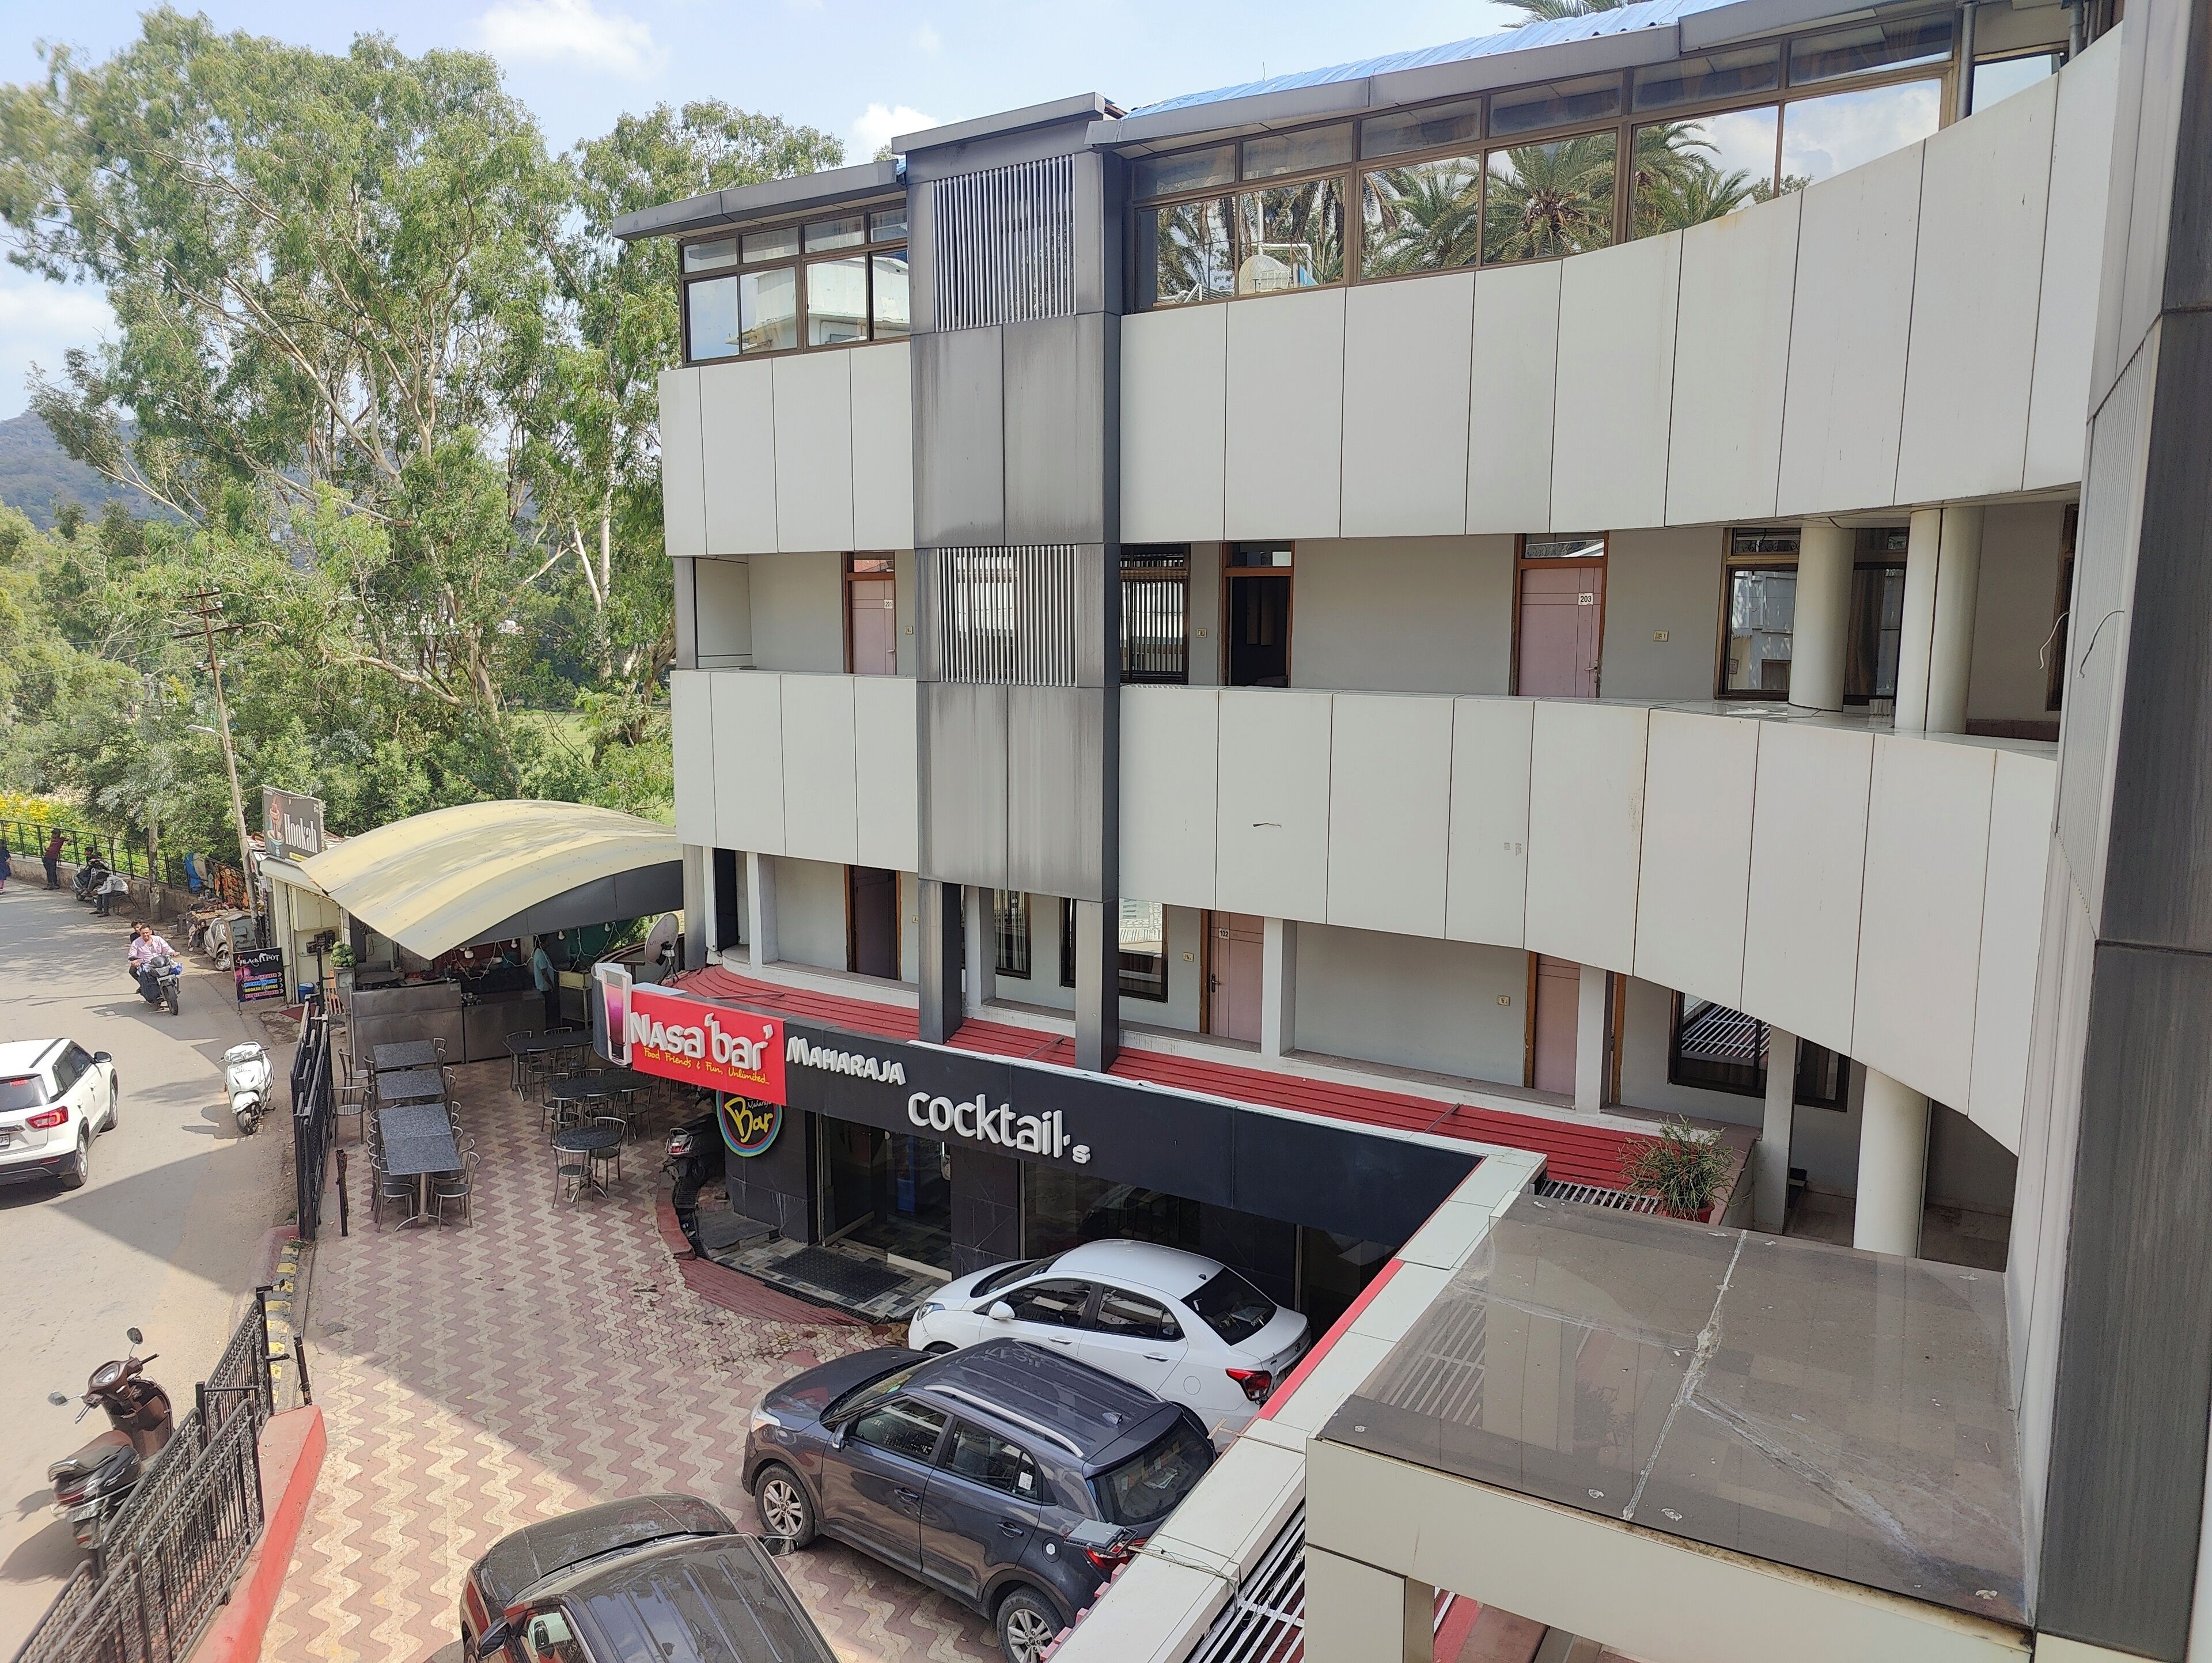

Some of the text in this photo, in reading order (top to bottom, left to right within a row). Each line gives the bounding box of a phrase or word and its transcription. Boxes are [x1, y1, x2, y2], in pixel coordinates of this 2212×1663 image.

[283, 813, 319, 853] Hookah
[643, 1047, 661, 1061] Food,
[665, 1052, 692, 1069] Friends
[696, 1060, 701, 1070] &
[704, 1060, 724, 1075] Fun,
[786, 1036, 907, 1086] MAHARAJA
[724, 1096, 774, 1143] Bar
